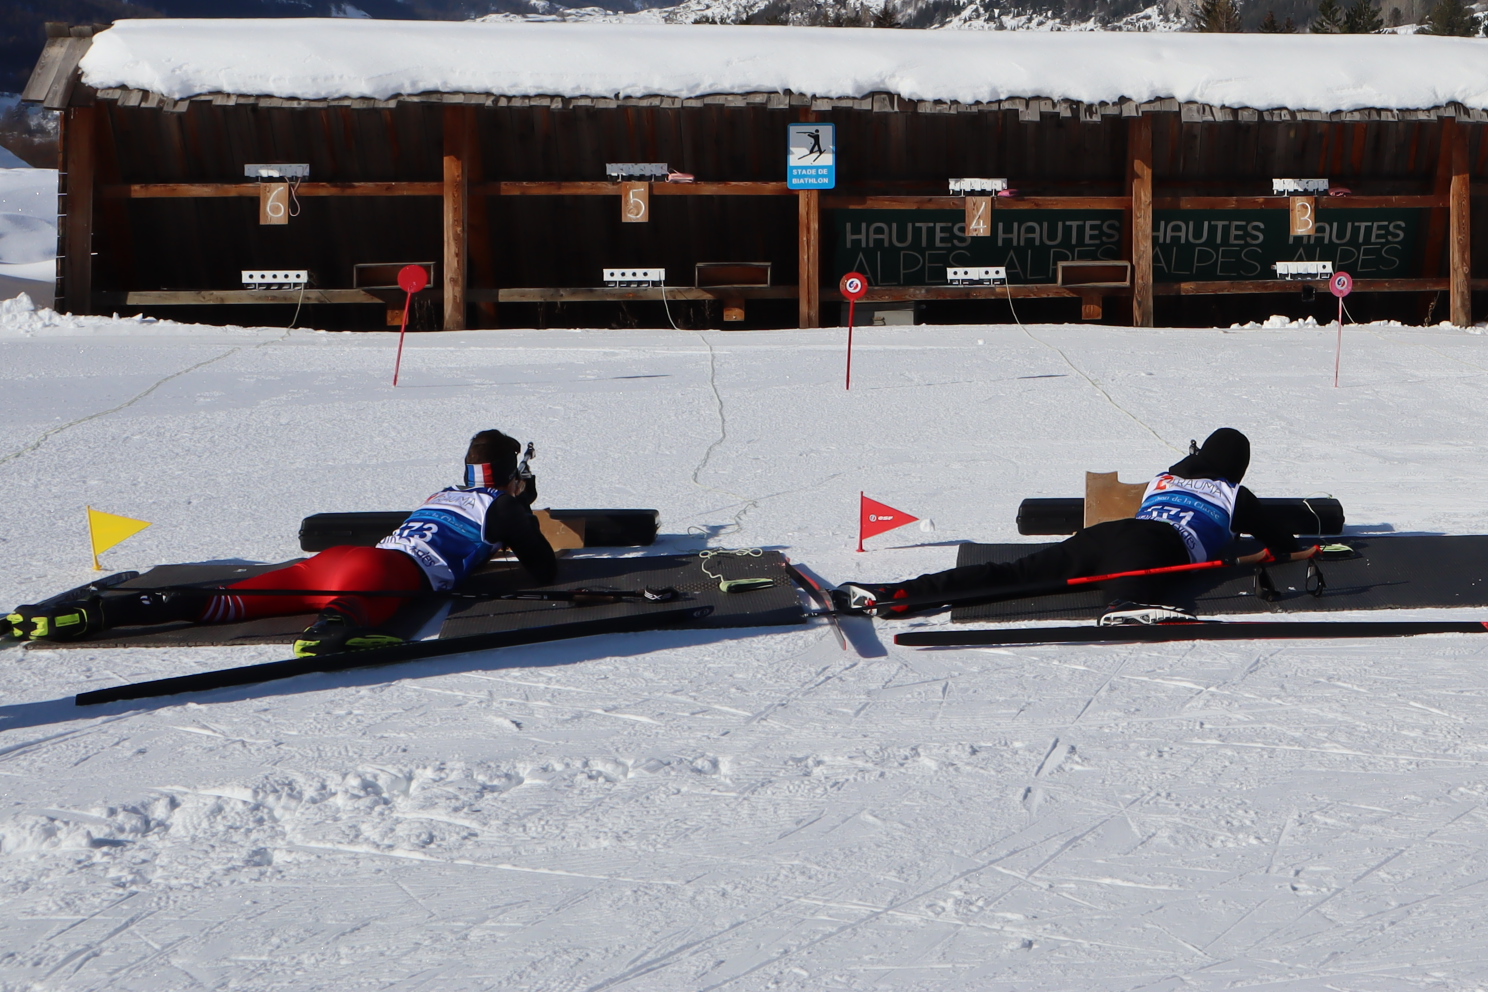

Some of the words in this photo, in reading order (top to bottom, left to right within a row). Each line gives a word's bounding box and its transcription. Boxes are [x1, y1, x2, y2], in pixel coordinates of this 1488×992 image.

[792, 168, 817, 176] STADE
[792, 177, 829, 185] BIATHLON
[266, 186, 285, 218] 6
[627, 188, 645, 219] 5
[969, 201, 987, 234] 4
[1296, 202, 1313, 232] 3
[845, 222, 972, 248] HAUTES
[997, 220, 1120, 247] HAUTES
[1288, 221, 1406, 244] AUTES
